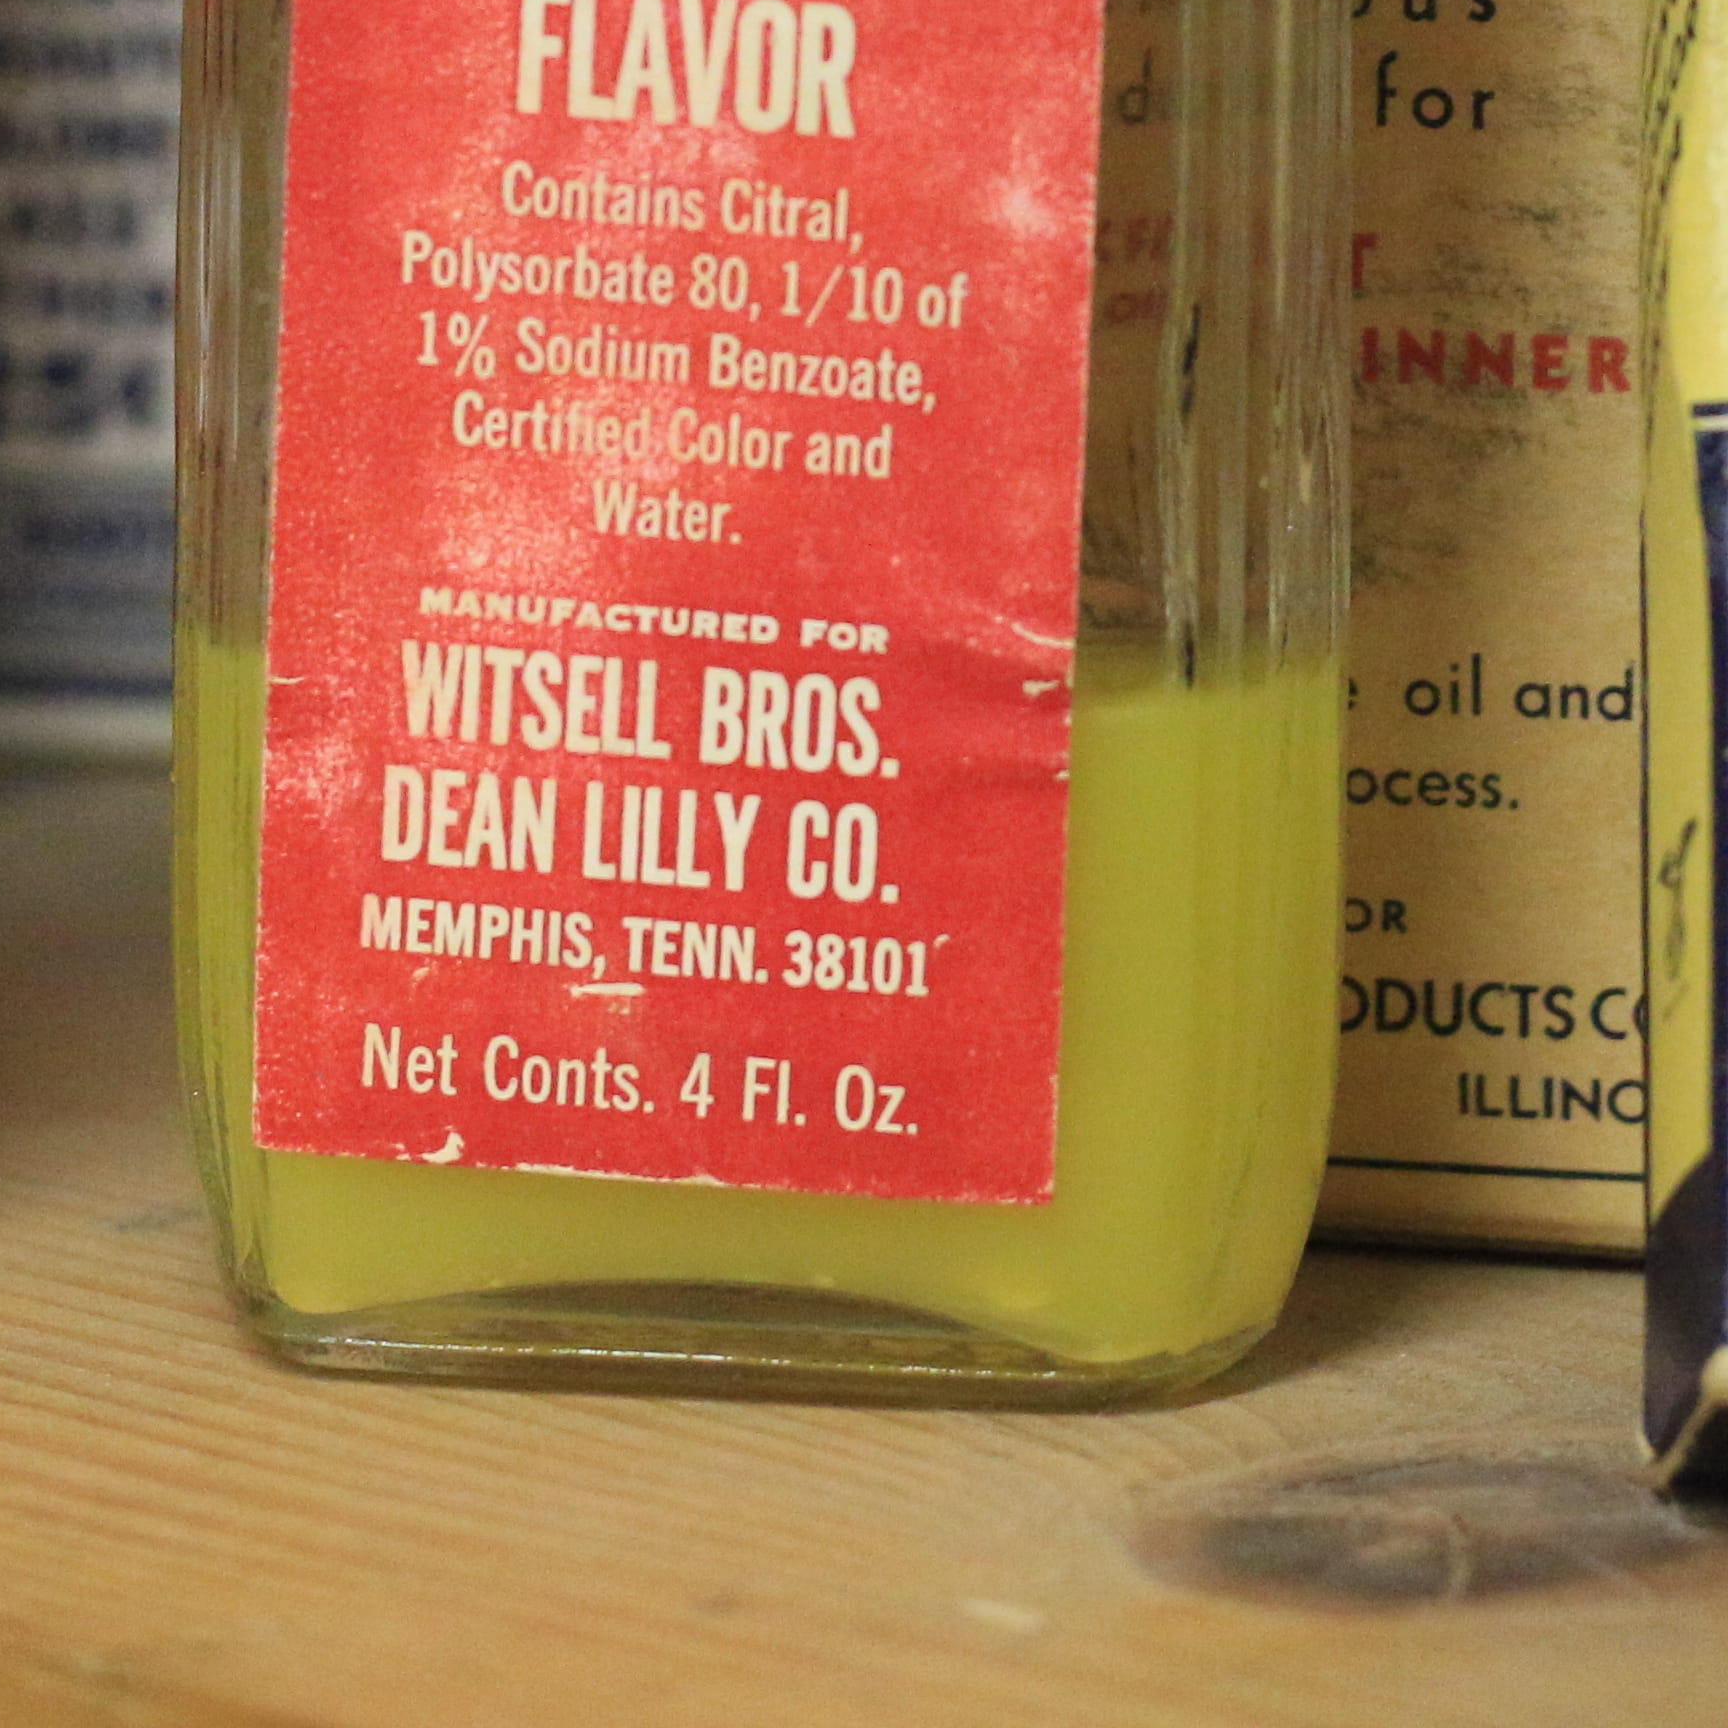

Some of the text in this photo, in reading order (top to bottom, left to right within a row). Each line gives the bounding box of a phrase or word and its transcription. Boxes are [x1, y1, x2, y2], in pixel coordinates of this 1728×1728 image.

[1376, 50, 1496, 130] for
[501, 160, 863, 254] Contains Citral,
[400, 230, 968, 329] Polysorbate 80, 1/10 of
[417, 310, 937, 414] 1% Sodium Benzoate,
[453, 391, 894, 479] Certified Color and
[592, 479, 743, 544] Water.
[419, 586, 890, 655] MANUFACTURED FOR
[401, 639, 901, 779] WITSELL BROS.
[1404, 653, 1484, 716] oil
[1513, 660, 1636, 722] and
[381, 764, 899, 903] DEAN LILLY CO.
[360, 893, 929, 996] MEMPHIS, TENN. 38101
[1590, 986, 1650, 1042] C
[362, 1022, 920, 1136] Net Conts. 4 Fl. Oz.
